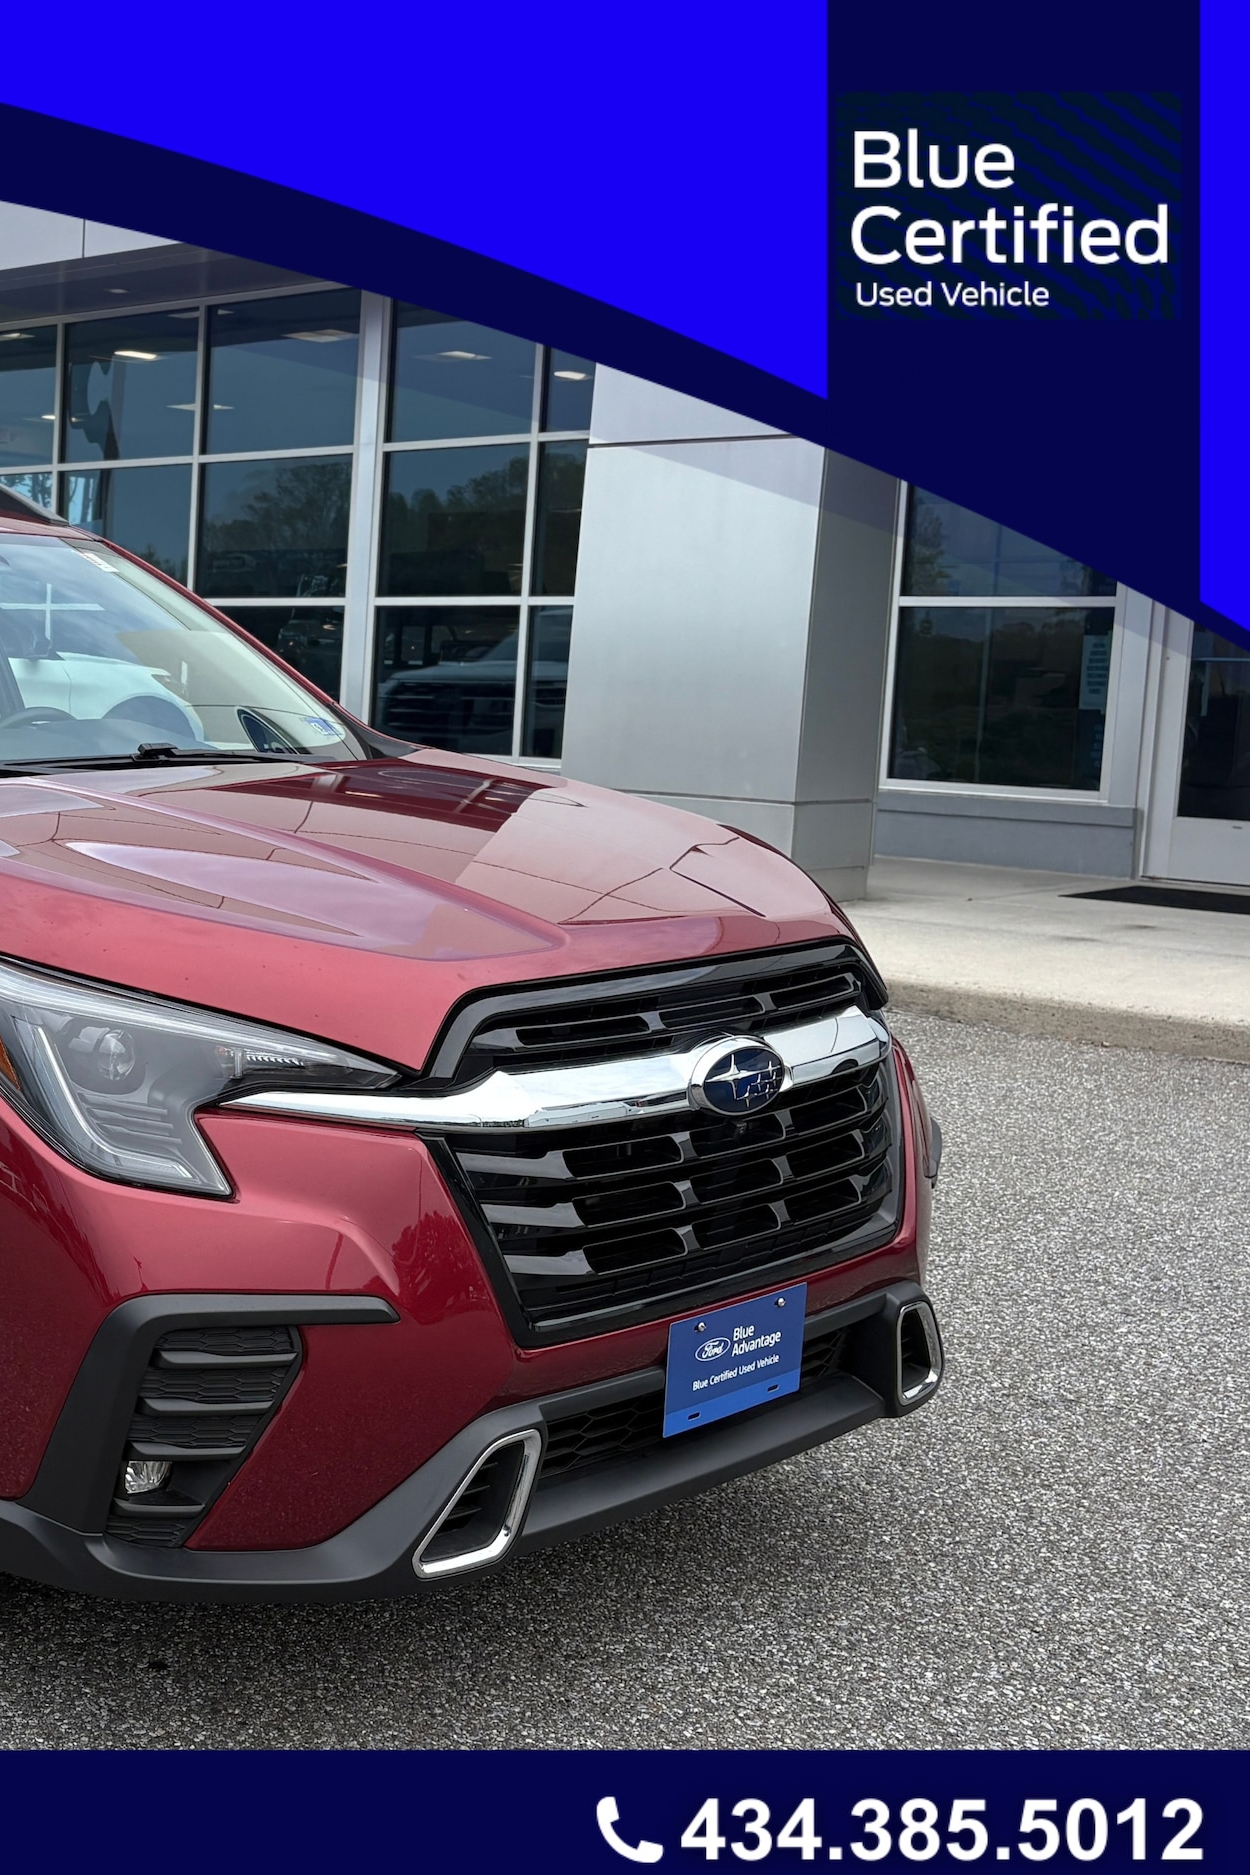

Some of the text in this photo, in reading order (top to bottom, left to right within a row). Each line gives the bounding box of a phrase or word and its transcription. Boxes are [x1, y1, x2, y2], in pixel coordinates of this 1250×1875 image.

[731, 1331, 782, 1357] Advantage
[733, 1324, 755, 1341] Blue
[692, 1353, 780, 1391] Blue Certified Used Vehicle
